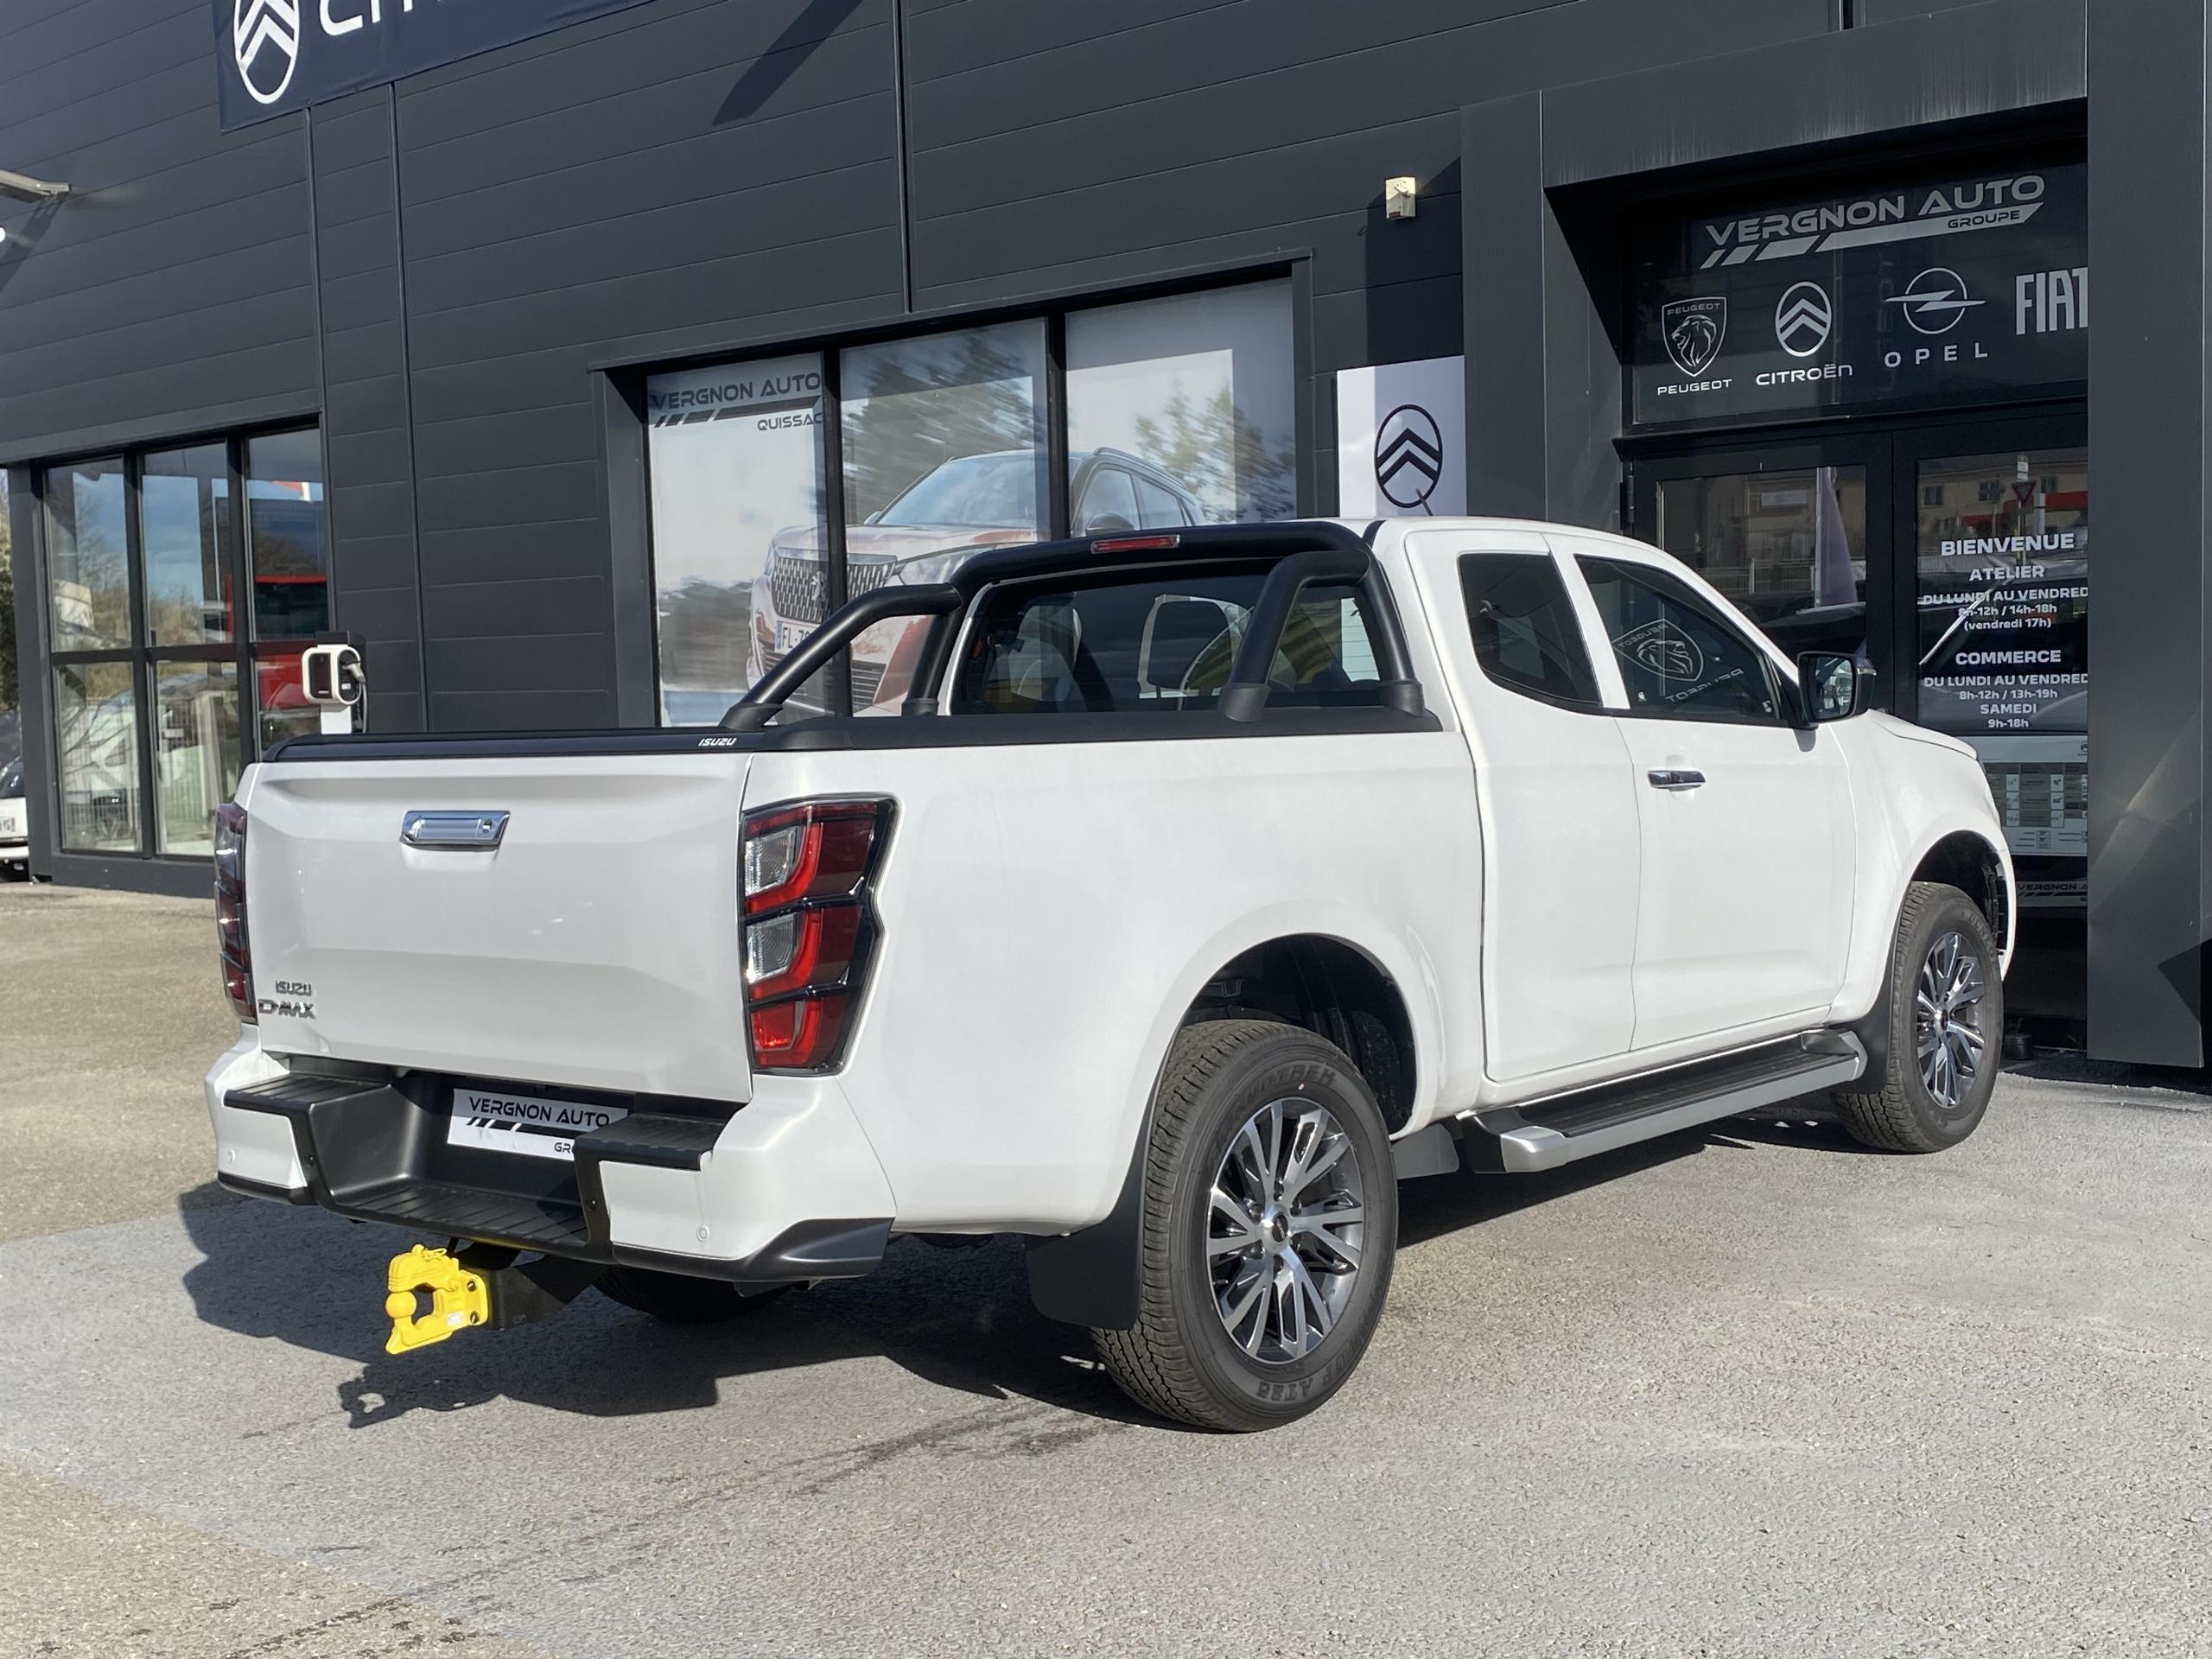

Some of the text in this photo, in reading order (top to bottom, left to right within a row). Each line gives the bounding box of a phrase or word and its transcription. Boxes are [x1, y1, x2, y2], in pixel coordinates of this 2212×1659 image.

[1705, 175, 2045, 246] VERGNON AUTO
[1947, 209, 2021, 229] GROUPE
[1667, 302, 1721, 316] PEUGEOT
[2016, 267, 2088, 335] FIAT
[1884, 342, 1988, 368] OPEL
[651, 372, 822, 410] VERGNON AUTO
[1657, 378, 1732, 396] PEUGEOT
[757, 412, 823, 431] QUISSAC
[1941, 532, 2075, 556] BIENVENUE
[1968, 565, 2045, 582] ATELIER
[1923, 587, 2088, 605] DU LUNDI AU VENDRED
[2009, 603, 2057, 615] 14h-18h
[1963, 617, 2052, 632] (vendredi 17h)
[1955, 650, 2062, 665] COMMERCE
[1923, 673, 2088, 687] DU LUNDI AU VENDRED
[1959, 690, 1999, 700] 8h-12h
[2010, 689, 2058, 699] 13h-19h
[1980, 703, 2037, 715] SAMEDI
[1987, 718, 2030, 728] 9h-18h
[697, 737, 737, 747] ISUZU
[275, 980, 313, 997] ISUZU
[468, 1096, 610, 1128] VERGNON AUTO
